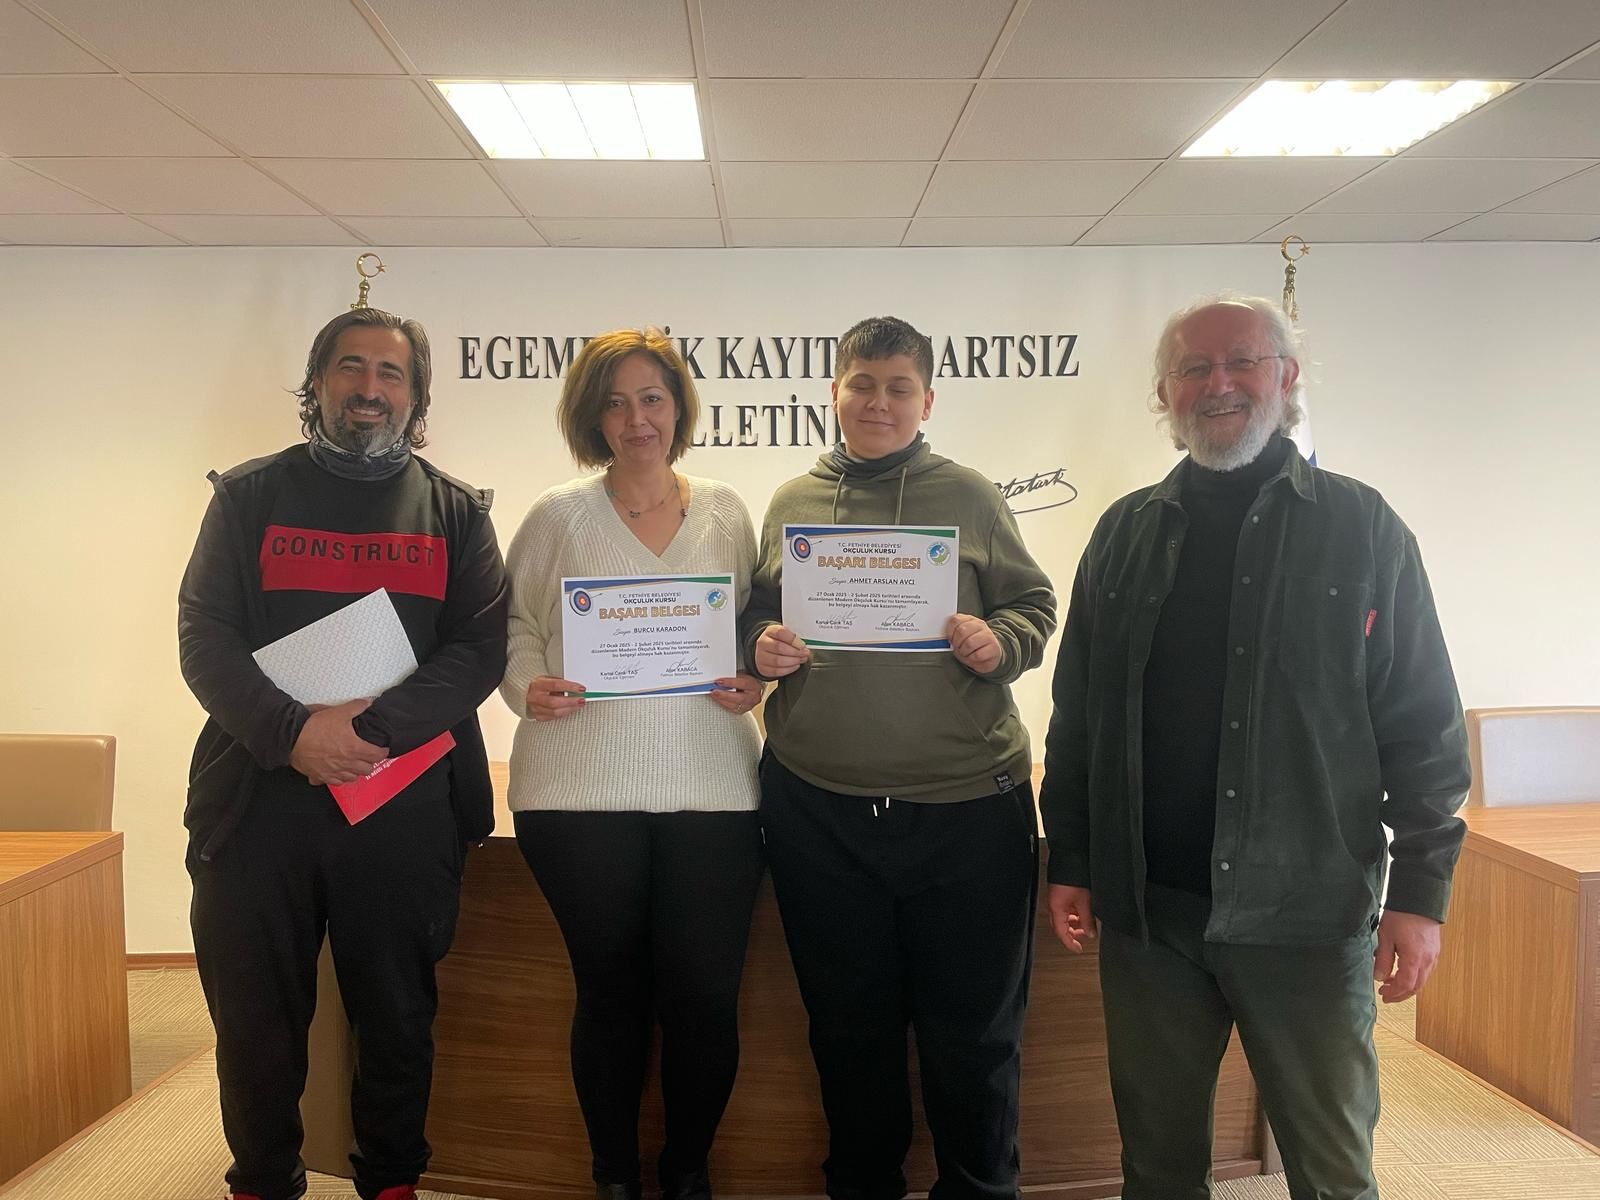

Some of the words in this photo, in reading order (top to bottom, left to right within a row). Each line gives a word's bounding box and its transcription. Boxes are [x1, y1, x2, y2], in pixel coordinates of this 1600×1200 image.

[930, 335, 1080, 379] ARTSIZ
[271, 536, 434, 566] CONSTRUCT
[818, 556, 866, 570] BAŞARI
[869, 557, 921, 569] BELGESİ
[599, 606, 647, 621] BAŞARI
[651, 605, 700, 618] BELGESİ
